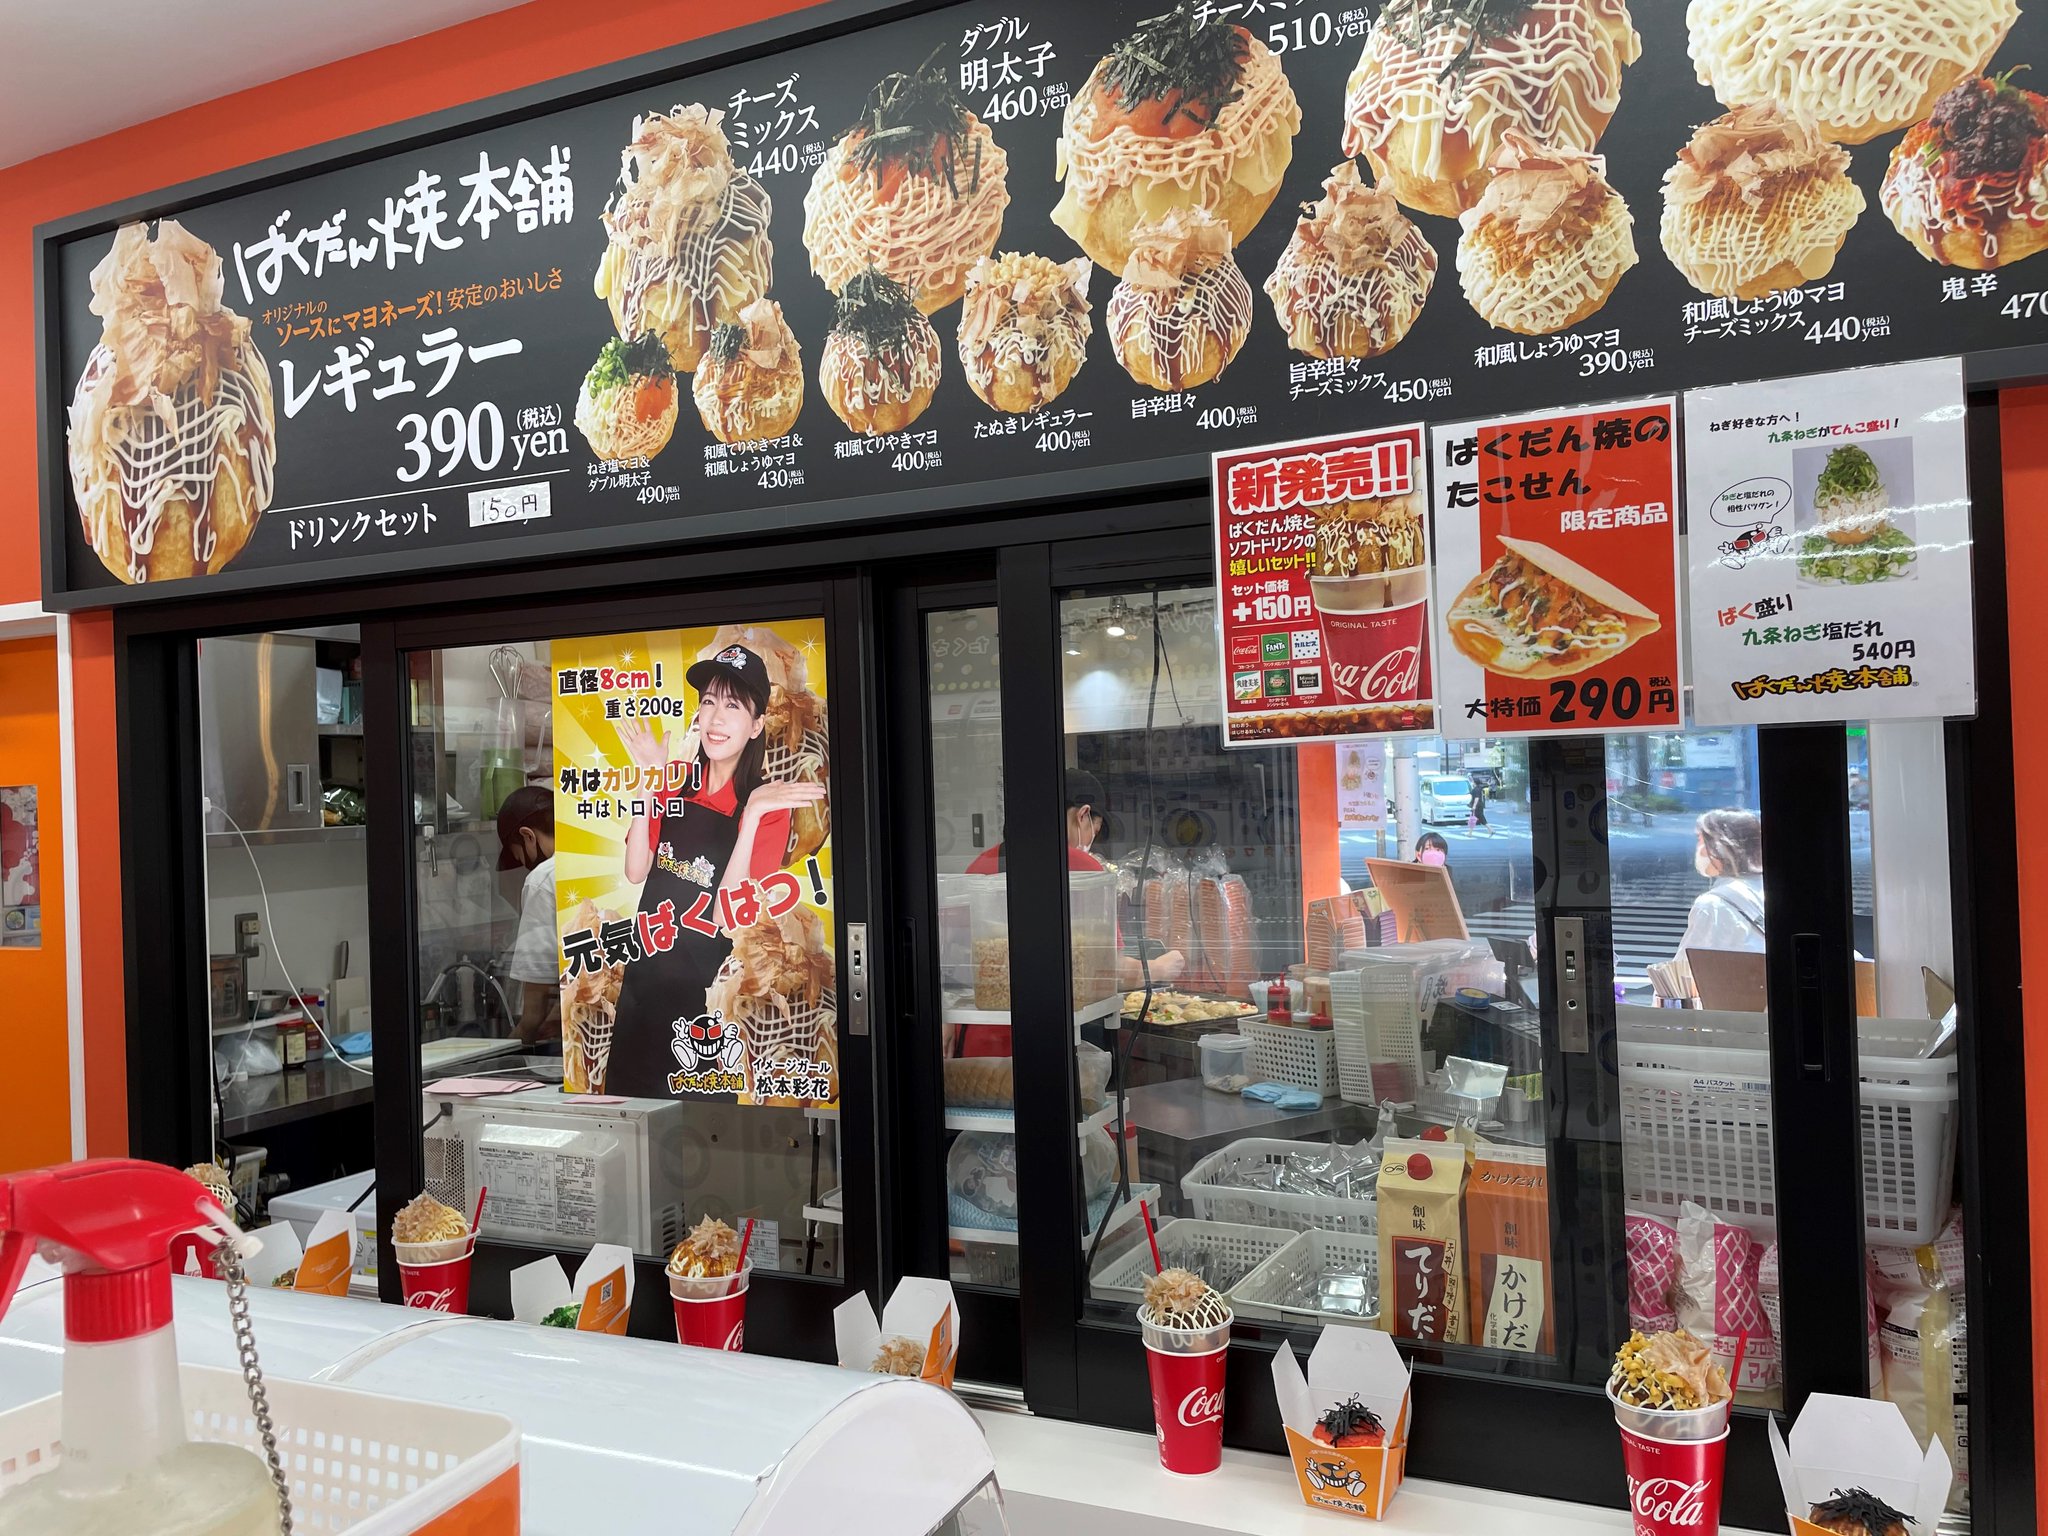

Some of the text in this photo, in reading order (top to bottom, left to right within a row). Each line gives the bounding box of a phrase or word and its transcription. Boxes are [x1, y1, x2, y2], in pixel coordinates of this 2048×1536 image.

[959, 16, 1030, 58] ダブル
[1267, 7, 1373, 56] 510 (税込) yen
[960, 41, 1057, 96] 明太子
[728, 72, 800, 121] チーズ
[982, 86, 1037, 124] 460
[1040, 92, 1073, 118] yen
[733, 104, 820, 150] ミックス
[748, 144, 798, 180] 440
[800, 149, 828, 173] yen
[233, 144, 574, 305] ばくだん焼本舗
[1941, 272, 1998, 303] 鬼辛
[262, 300, 328, 325] オリジナルの
[1682, 281, 1845, 325] 和風しょうゆマヨ
[1683, 311, 1807, 344] チーズミックス
[1804, 316, 1861, 345] 440
[1861, 323, 1891, 342] yen
[1474, 328, 1620, 369] 和風しょうゆマヨ
[278, 327, 524, 419] レギュラー
[1578, 350, 1627, 377] 390
[1628, 356, 1655, 374] yen
[1288, 371, 1387, 402] チーズミックス
[1384, 378, 1428, 404] 450
[1428, 384, 1452, 402] yen
[973, 409, 1093, 439] たぬきレギュラー
[1196, 406, 1236, 430] 400
[1236, 413, 1258, 429] yen
[1709, 411, 1800, 433] ねぎ好きな方へ!
[396, 401, 569, 482] 390 (税込) yen
[703, 433, 803, 461] 和風てりやきマヨ&
[834, 429, 938, 459] 和風てりやきマヨ
[1035, 430, 1071, 452] 400
[1071, 437, 1091, 451] yen
[1445, 415, 1670, 467] ばくだん焼の
[587, 455, 650, 477] ねぎ塩マヨ&
[704, 453, 795, 478] 和風しょうゆマヨ
[891, 451, 924, 472] 400
[924, 457, 942, 471] yen
[588, 472, 652, 493] ダブル明太子
[757, 469, 787, 489] 430
[788, 475, 804, 488] yen
[1229, 440, 1412, 514] 新発売!!
[1446, 468, 1592, 508] たこせん
[480, 493, 538, 523] 150円
[637, 485, 664, 504] 490
[664, 491, 680, 502] yen
[1721, 489, 1775, 502] ねぎと塩だれの
[288, 503, 437, 550] ドリンクセット
[1229, 515, 1316, 539] ばくだん焼と
[1560, 502, 1668, 533] 限定商品
[1229, 533, 1316, 557] ソフトドリンクの
[1229, 552, 1317, 577] 嬉しいセット!!
[1232, 580, 1290, 597] セット価格
[1232, 595, 1312, 623] +150円
[1717, 594, 1793, 627] ばく盛り
[1330, 618, 1398, 629] ORIGINAL TASTE
[1742, 620, 1884, 647] 九条ねぎ塩だれ
[1852, 639, 1916, 662] 540円
[558, 662, 663, 695] 直径8cm!
[1731, 664, 1913, 702] ばくだん焼本舗
[605, 697, 683, 719] 重さ200g
[1465, 696, 1541, 719] 大特価
[1550, 676, 1641, 723] 290
[560, 763, 702, 794] 外はカリカリ!
[577, 798, 684, 820] 中はトロトロ
[562, 857, 829, 978] 元気ばくはつ!
[753, 1059, 831, 1074] イメージガール
[668, 1069, 746, 1093] ばくだん焼本舗
[755, 1076, 829, 1100] 松本彩花
[1479, 1170, 1544, 1188] かけだれ
[1412, 1204, 1426, 1231] 創味
[1504, 1221, 1518, 1249] 創味
[1404, 1246, 1437, 1340] てりだ
[1637, 1442, 1660, 1455] TASTE
